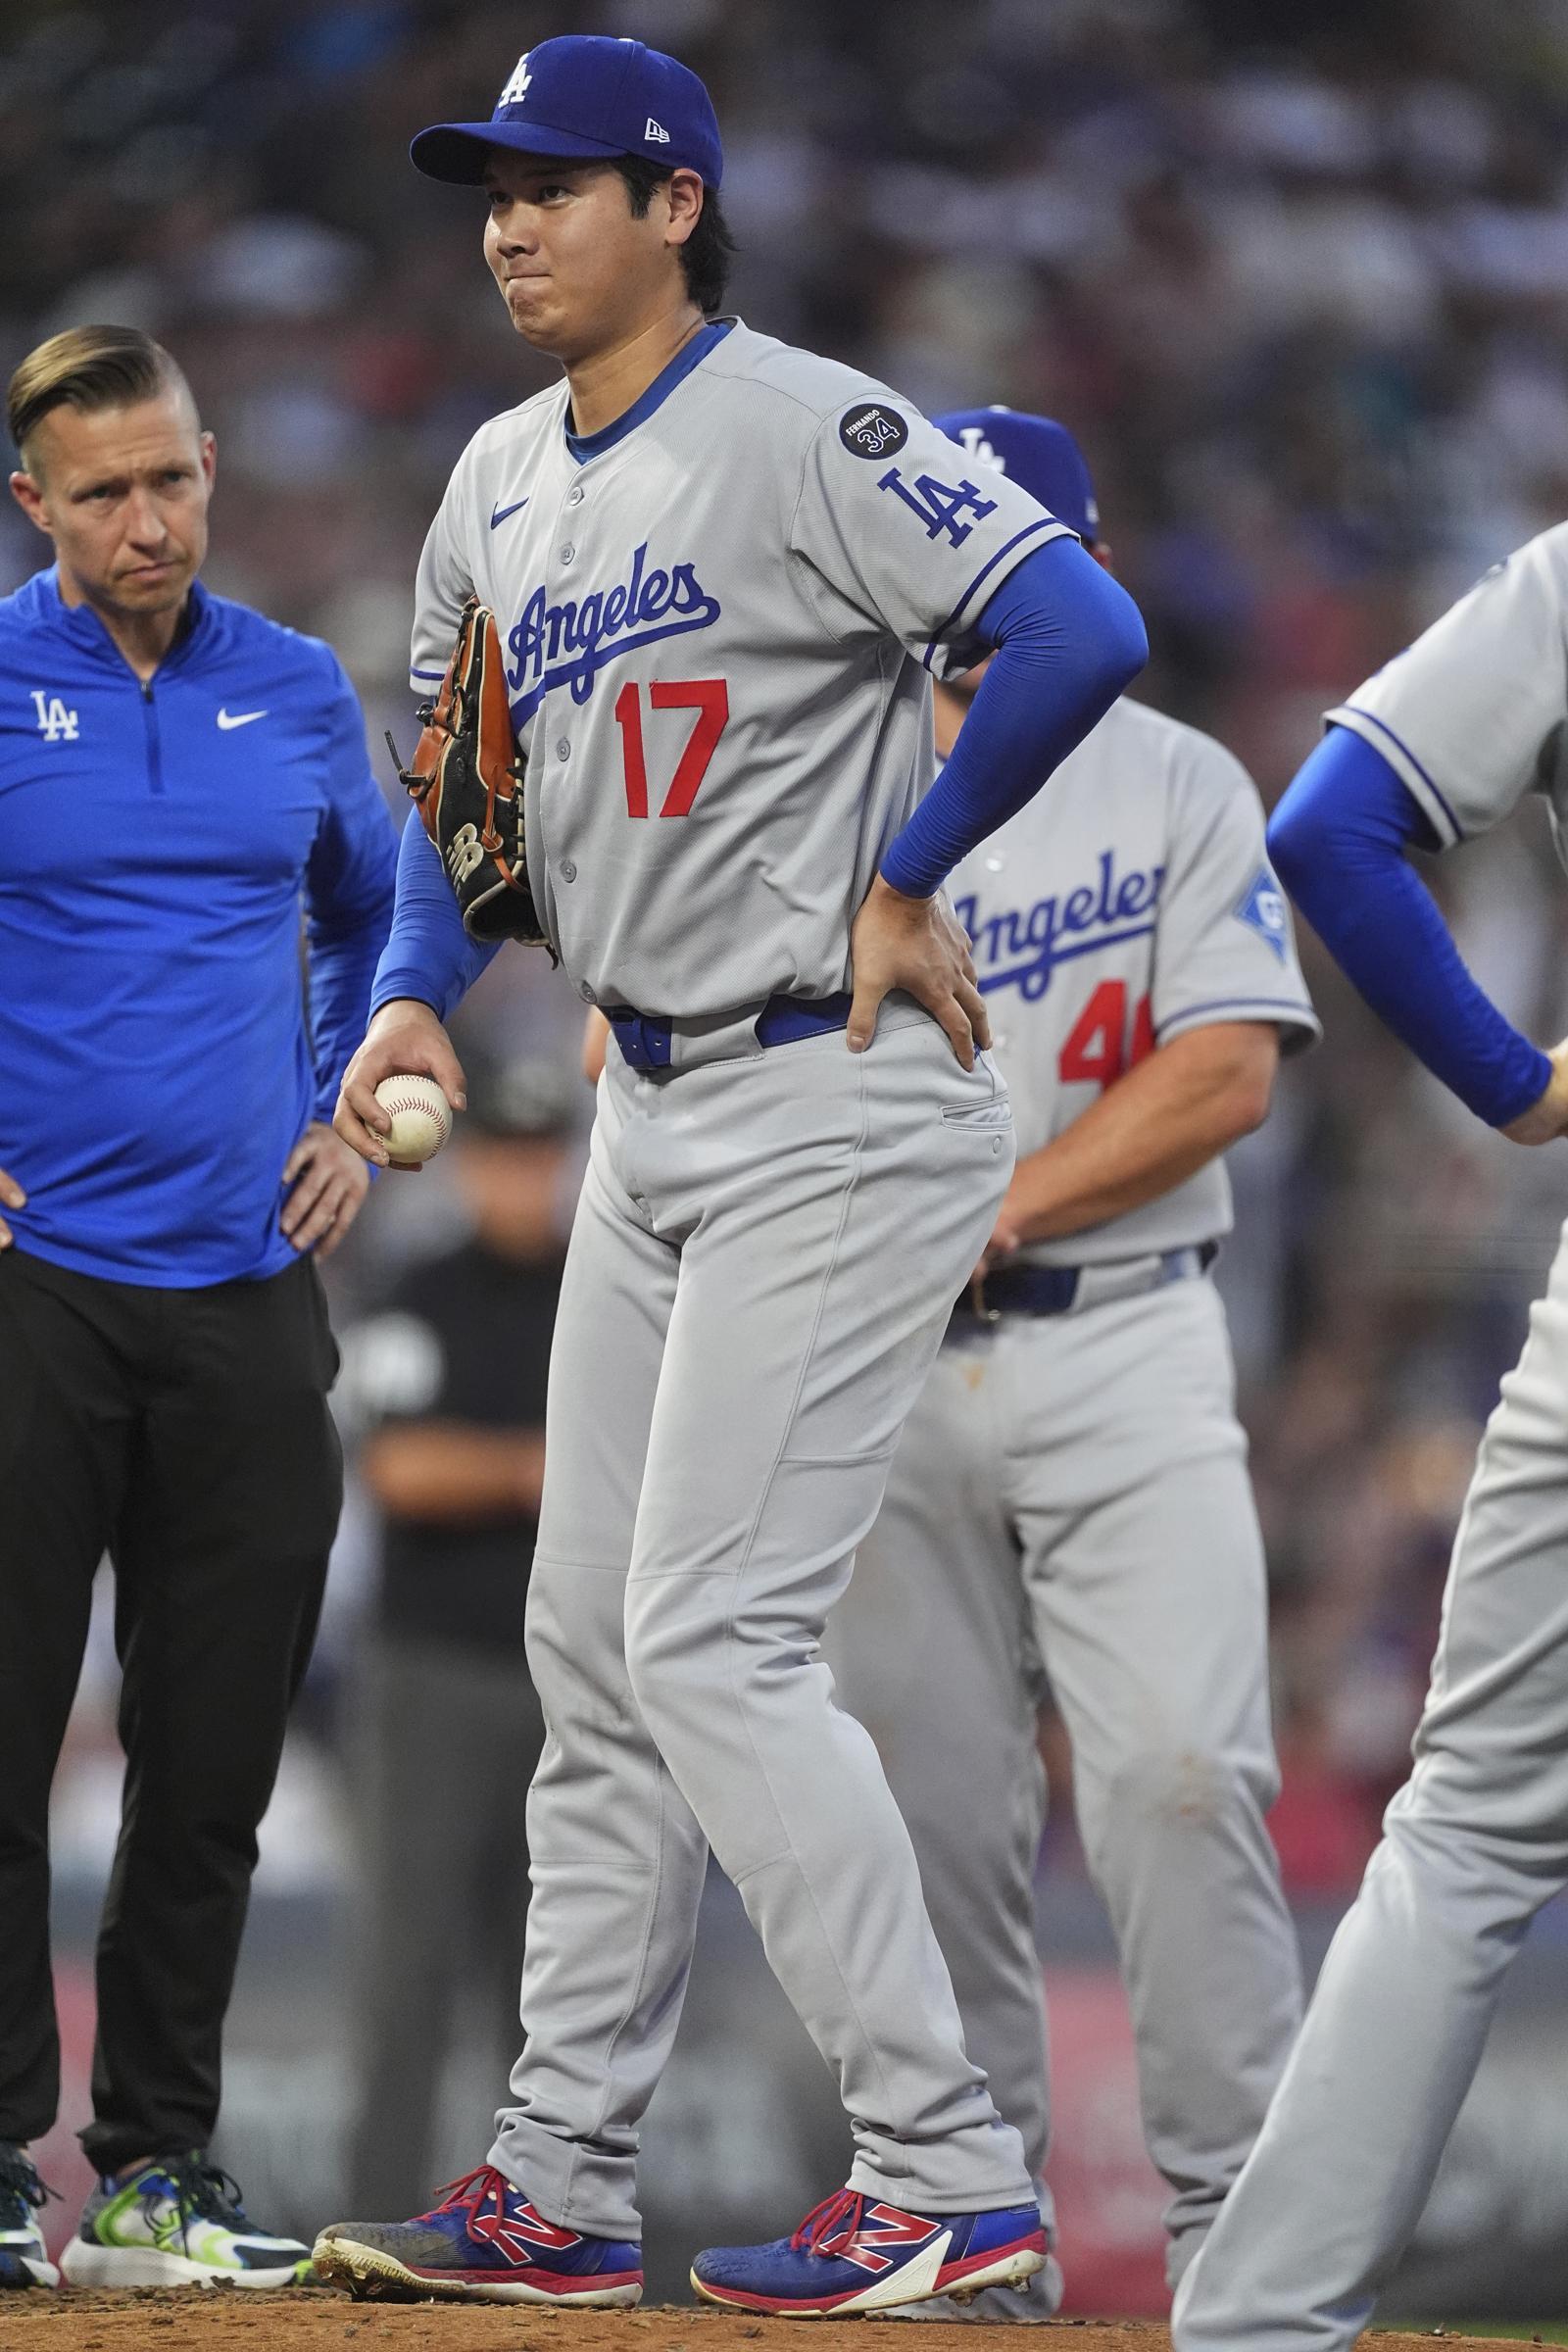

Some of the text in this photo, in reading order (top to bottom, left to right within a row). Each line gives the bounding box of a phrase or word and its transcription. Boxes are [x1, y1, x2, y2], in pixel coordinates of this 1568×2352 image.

[846, 410, 880, 437] FERNANDO
[858, 417, 901, 453] 34
[877, 467, 999, 550] LA
[508, 542, 720, 706] Angeles
[29, 690, 79, 741] LA
[614, 679, 729, 819] 17
